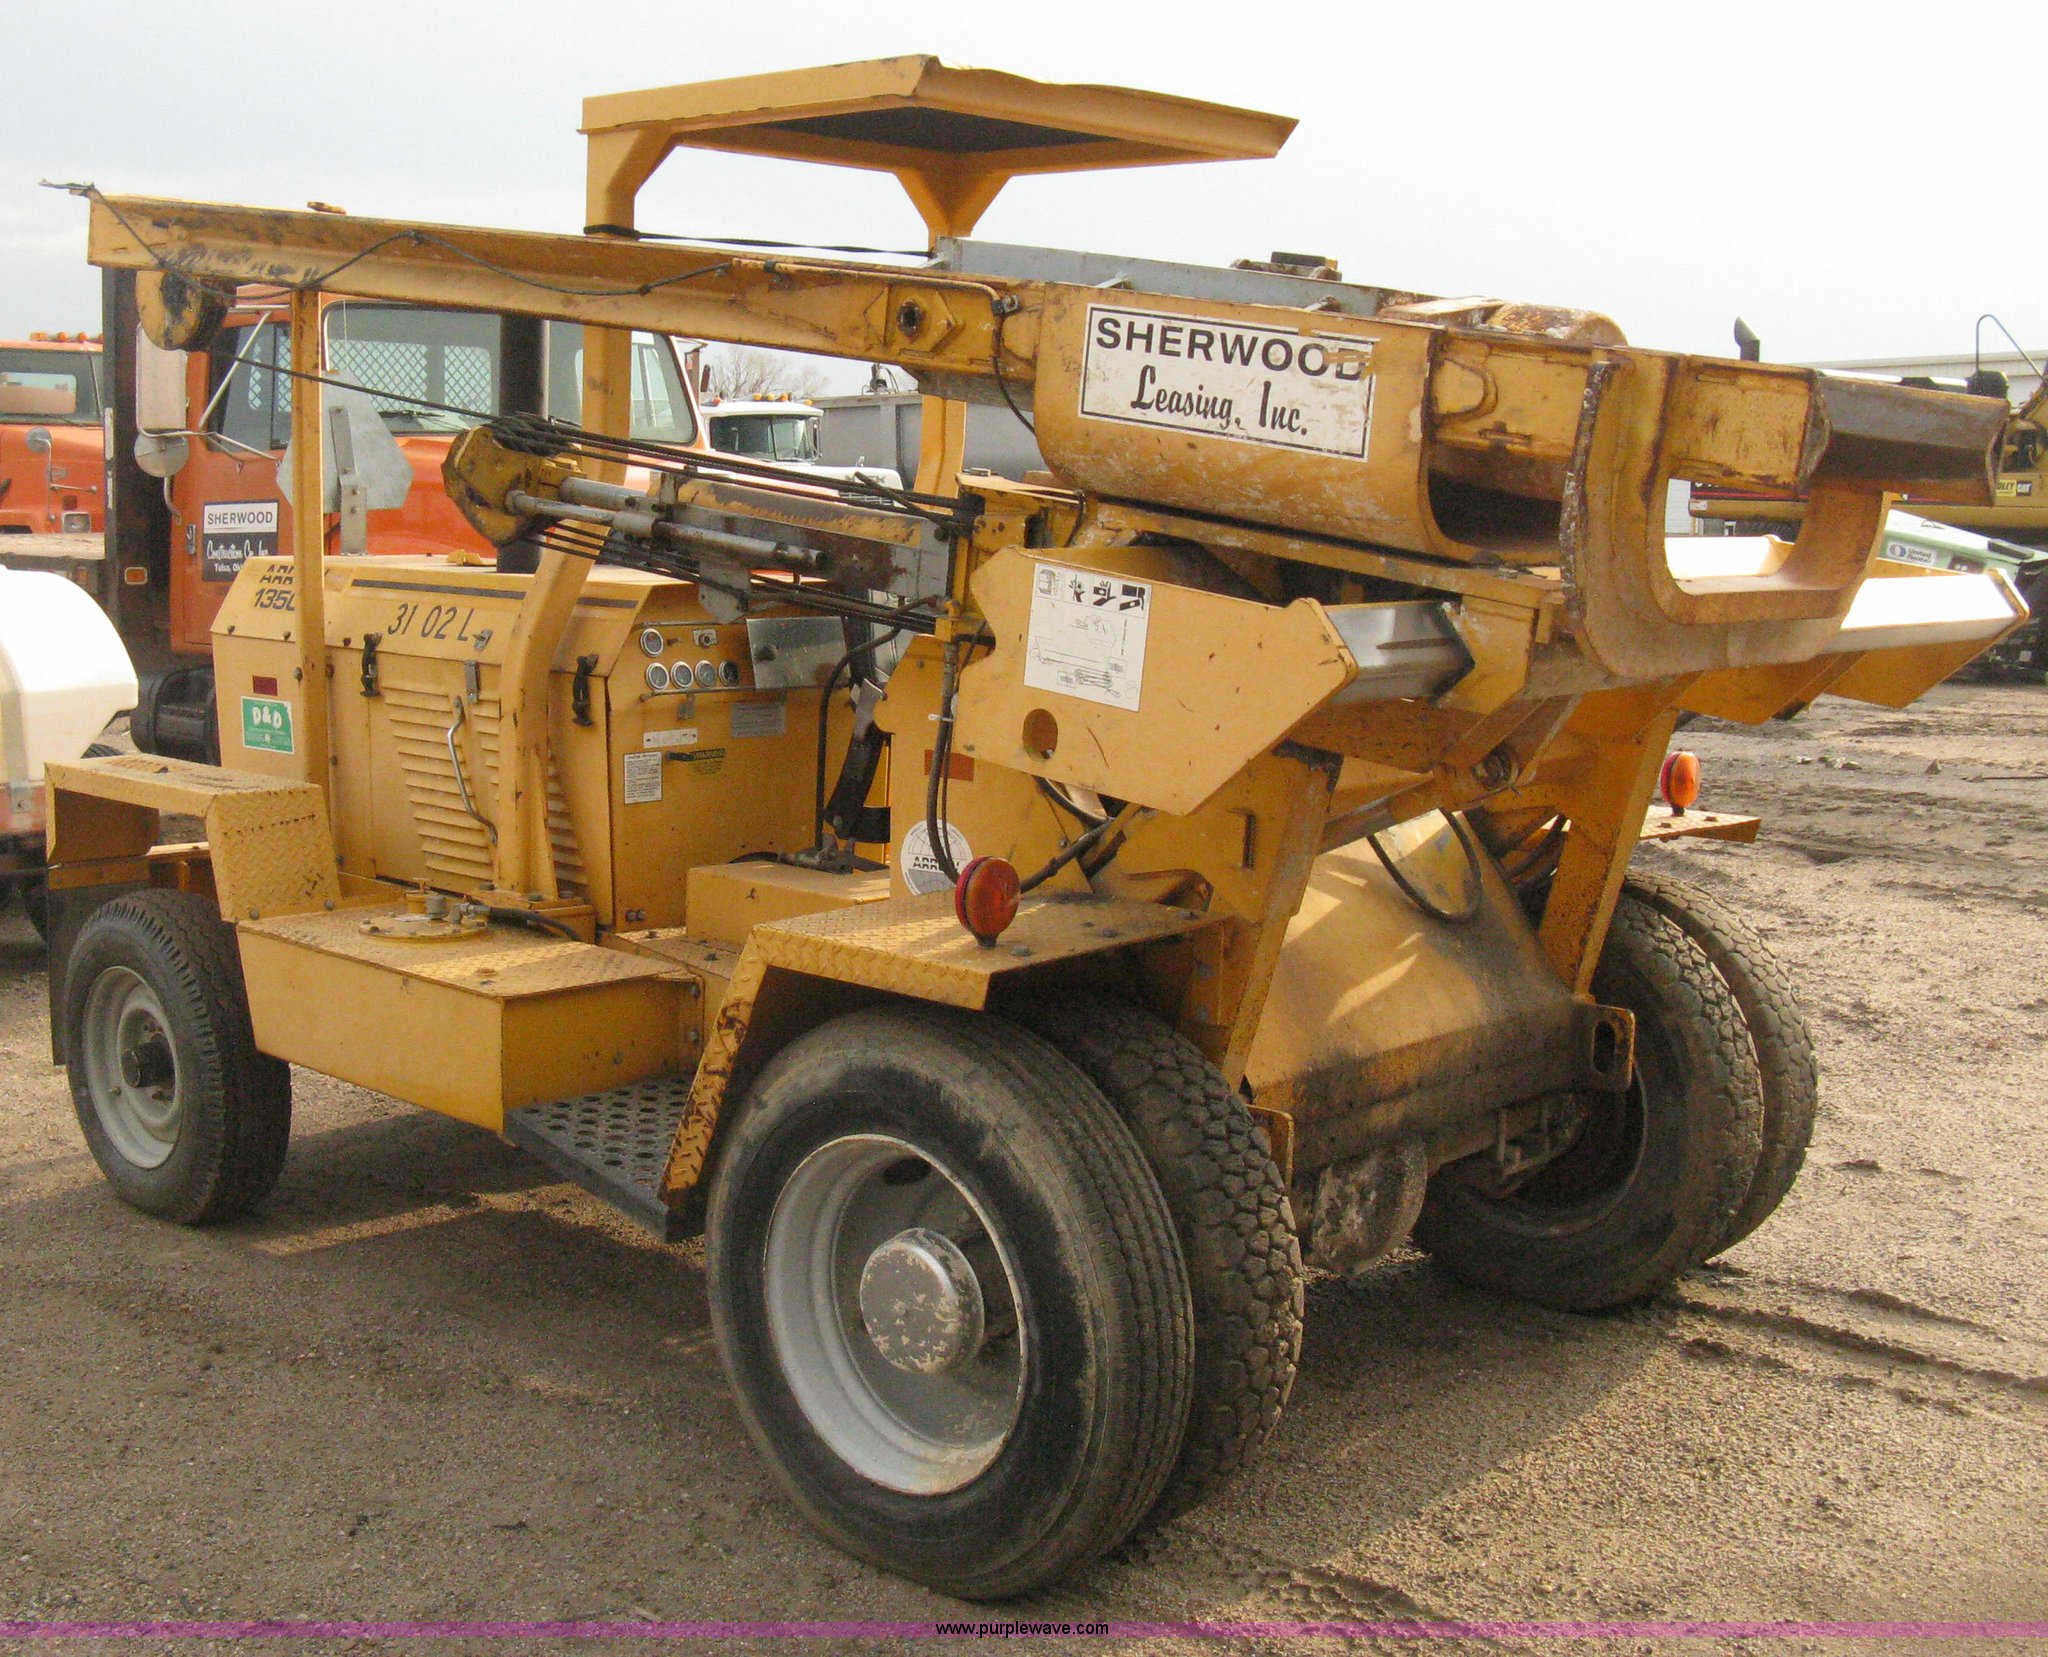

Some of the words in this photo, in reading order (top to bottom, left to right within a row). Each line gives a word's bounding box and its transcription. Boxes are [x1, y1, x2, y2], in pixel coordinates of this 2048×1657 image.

[1095, 316, 1366, 382] SHERWOOD
[1130, 365, 1246, 430] Leasing,
[1258, 380, 1308, 436] Inc.
[207, 511, 274, 525] SHERWOOD
[388, 603, 419, 635] 31
[421, 605, 458, 640] 02
[251, 705, 283, 730] D&D
